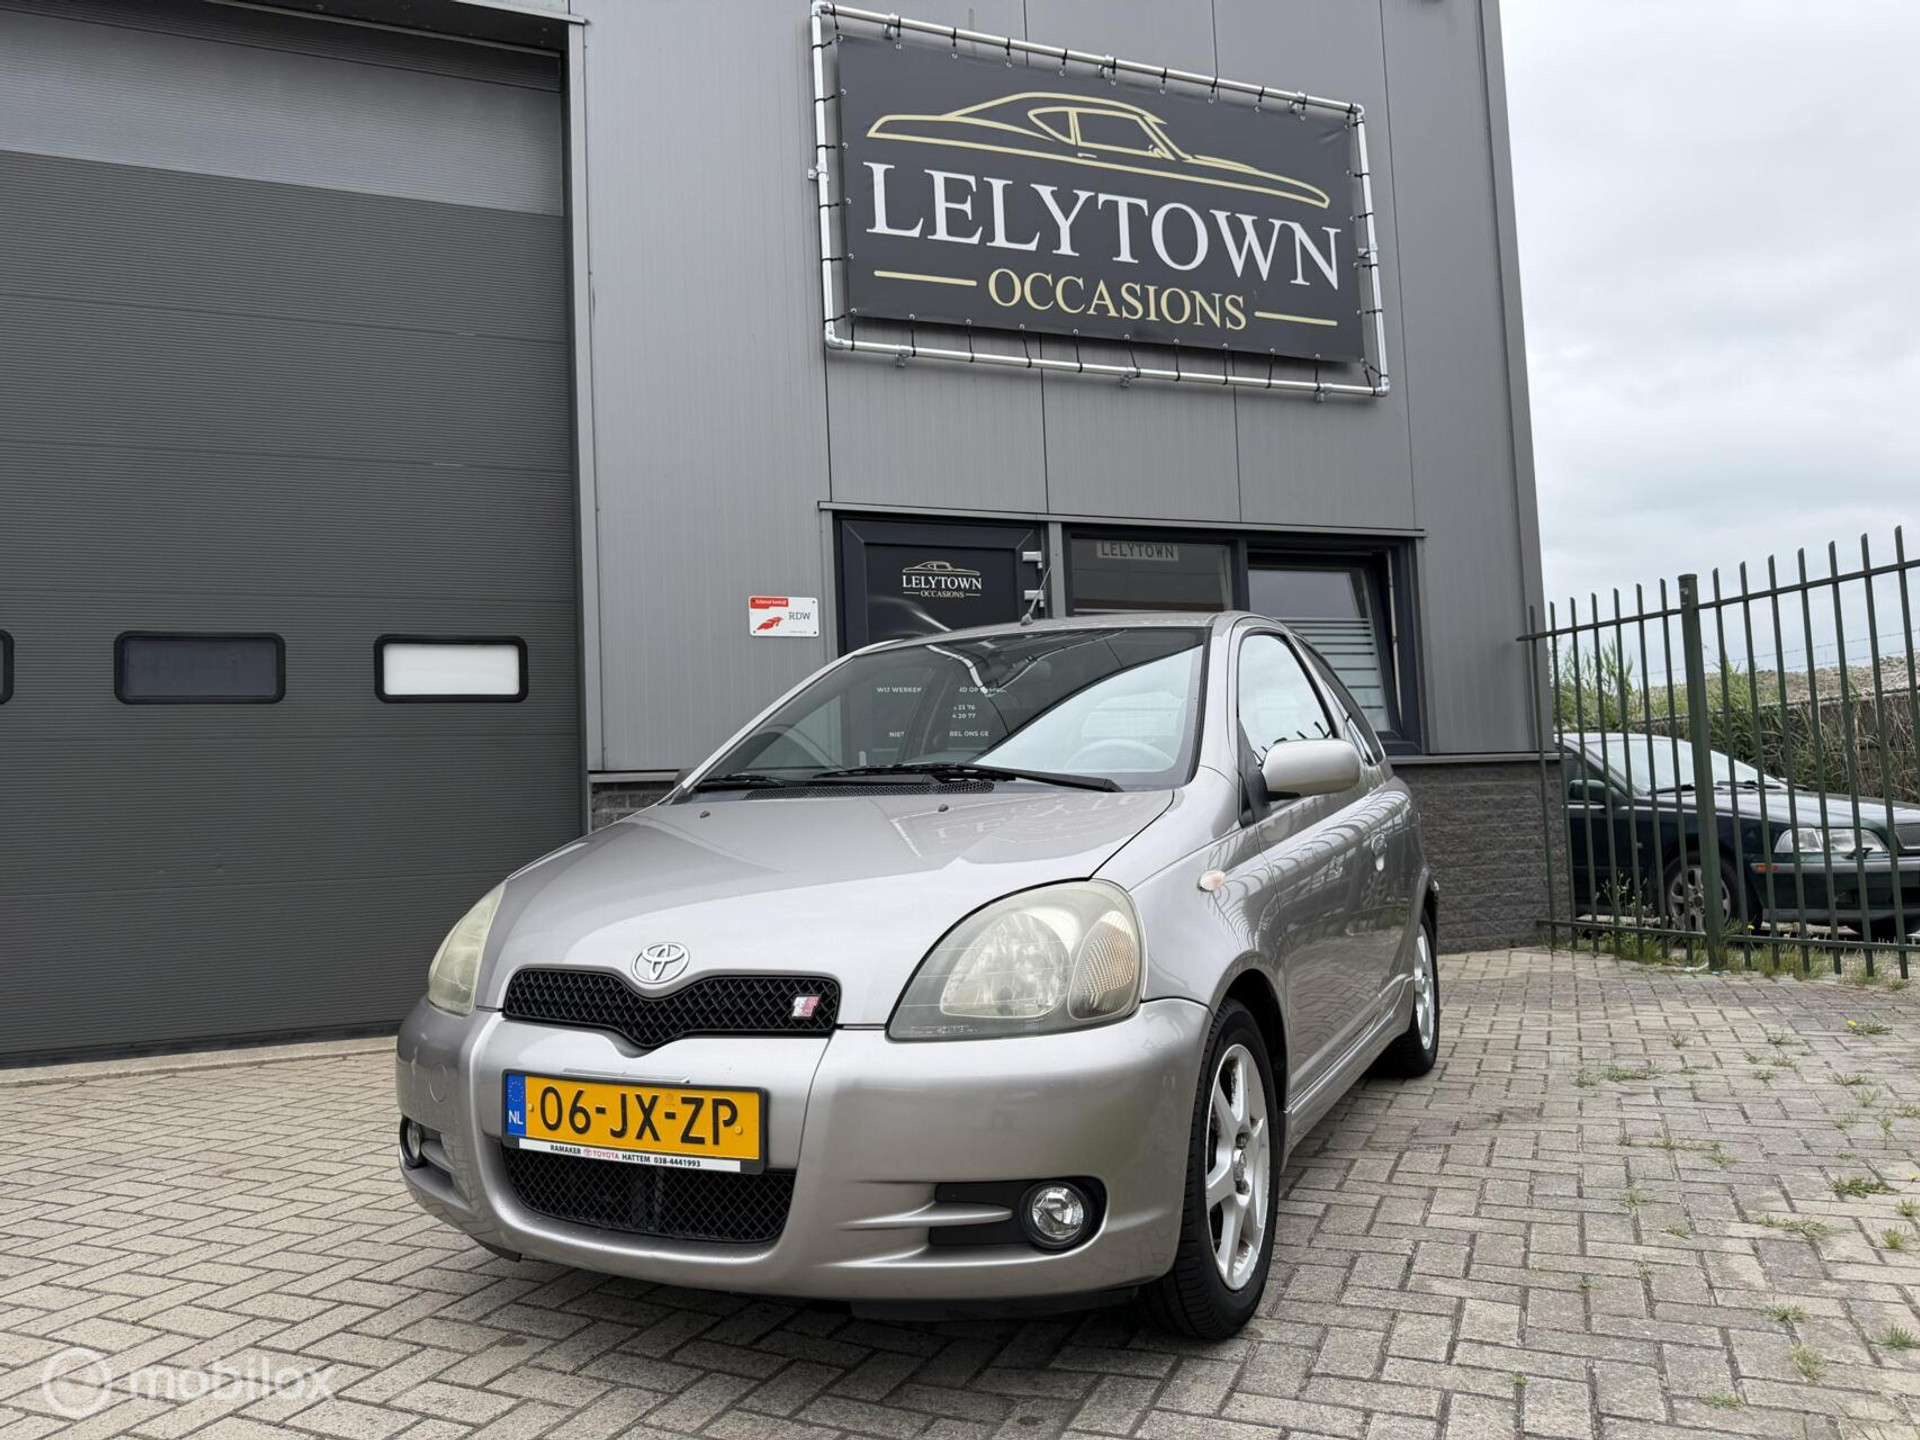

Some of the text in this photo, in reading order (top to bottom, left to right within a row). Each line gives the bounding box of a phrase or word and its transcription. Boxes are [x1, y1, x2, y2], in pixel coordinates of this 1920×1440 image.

[863, 161, 1341, 290] LELYTOWN
[988, 268, 1247, 330] OCCASIONS
[1101, 541, 1175, 559] LELYTOWN
[902, 575, 982, 590] LELYTOWN
[920, 590, 965, 598] OCCASIONS
[789, 612, 811, 620] RDW
[508, 1110, 523, 1125] NL
[540, 1086, 738, 1146] 06-JX-ZP
[550, 1144, 701, 1168] RAMAKER TOYOTA HATTEM 038-4441993
